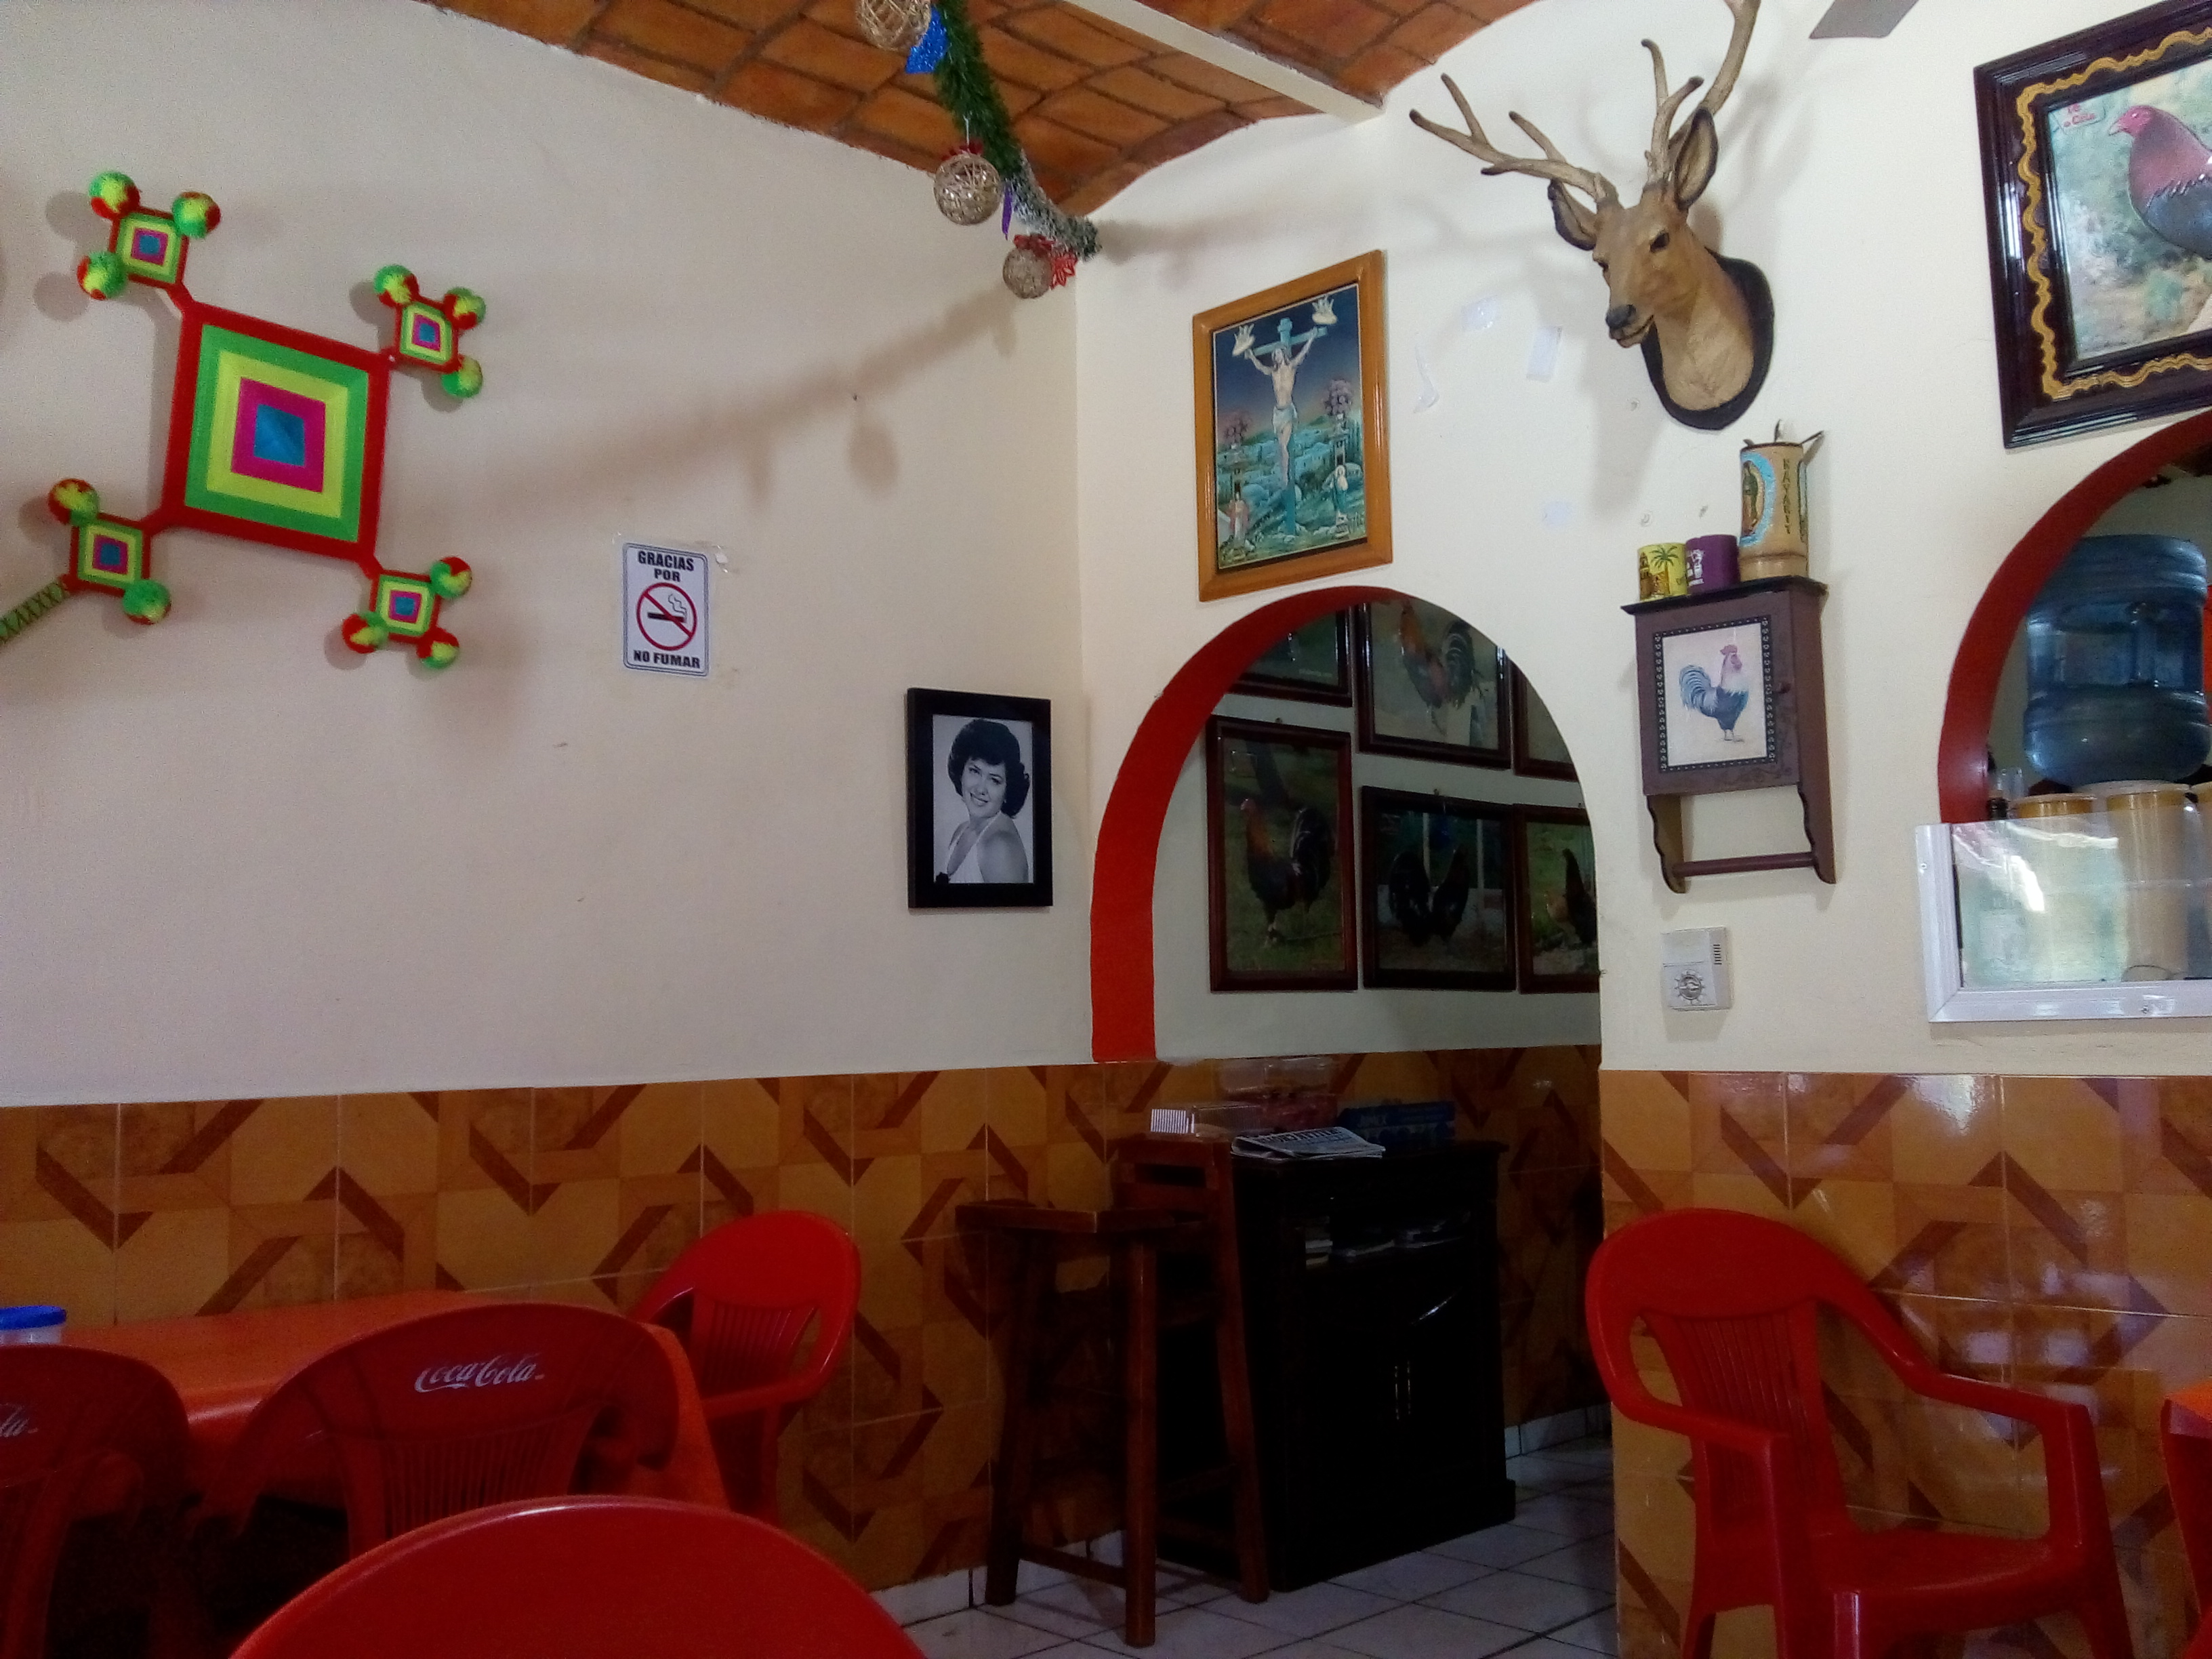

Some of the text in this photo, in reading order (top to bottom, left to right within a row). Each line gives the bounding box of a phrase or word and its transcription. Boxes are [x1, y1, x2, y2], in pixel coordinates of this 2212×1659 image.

[638, 550, 694, 571] GRACIAS
[654, 568, 680, 582] POR
[634, 650, 700, 668] NO FUMAR
